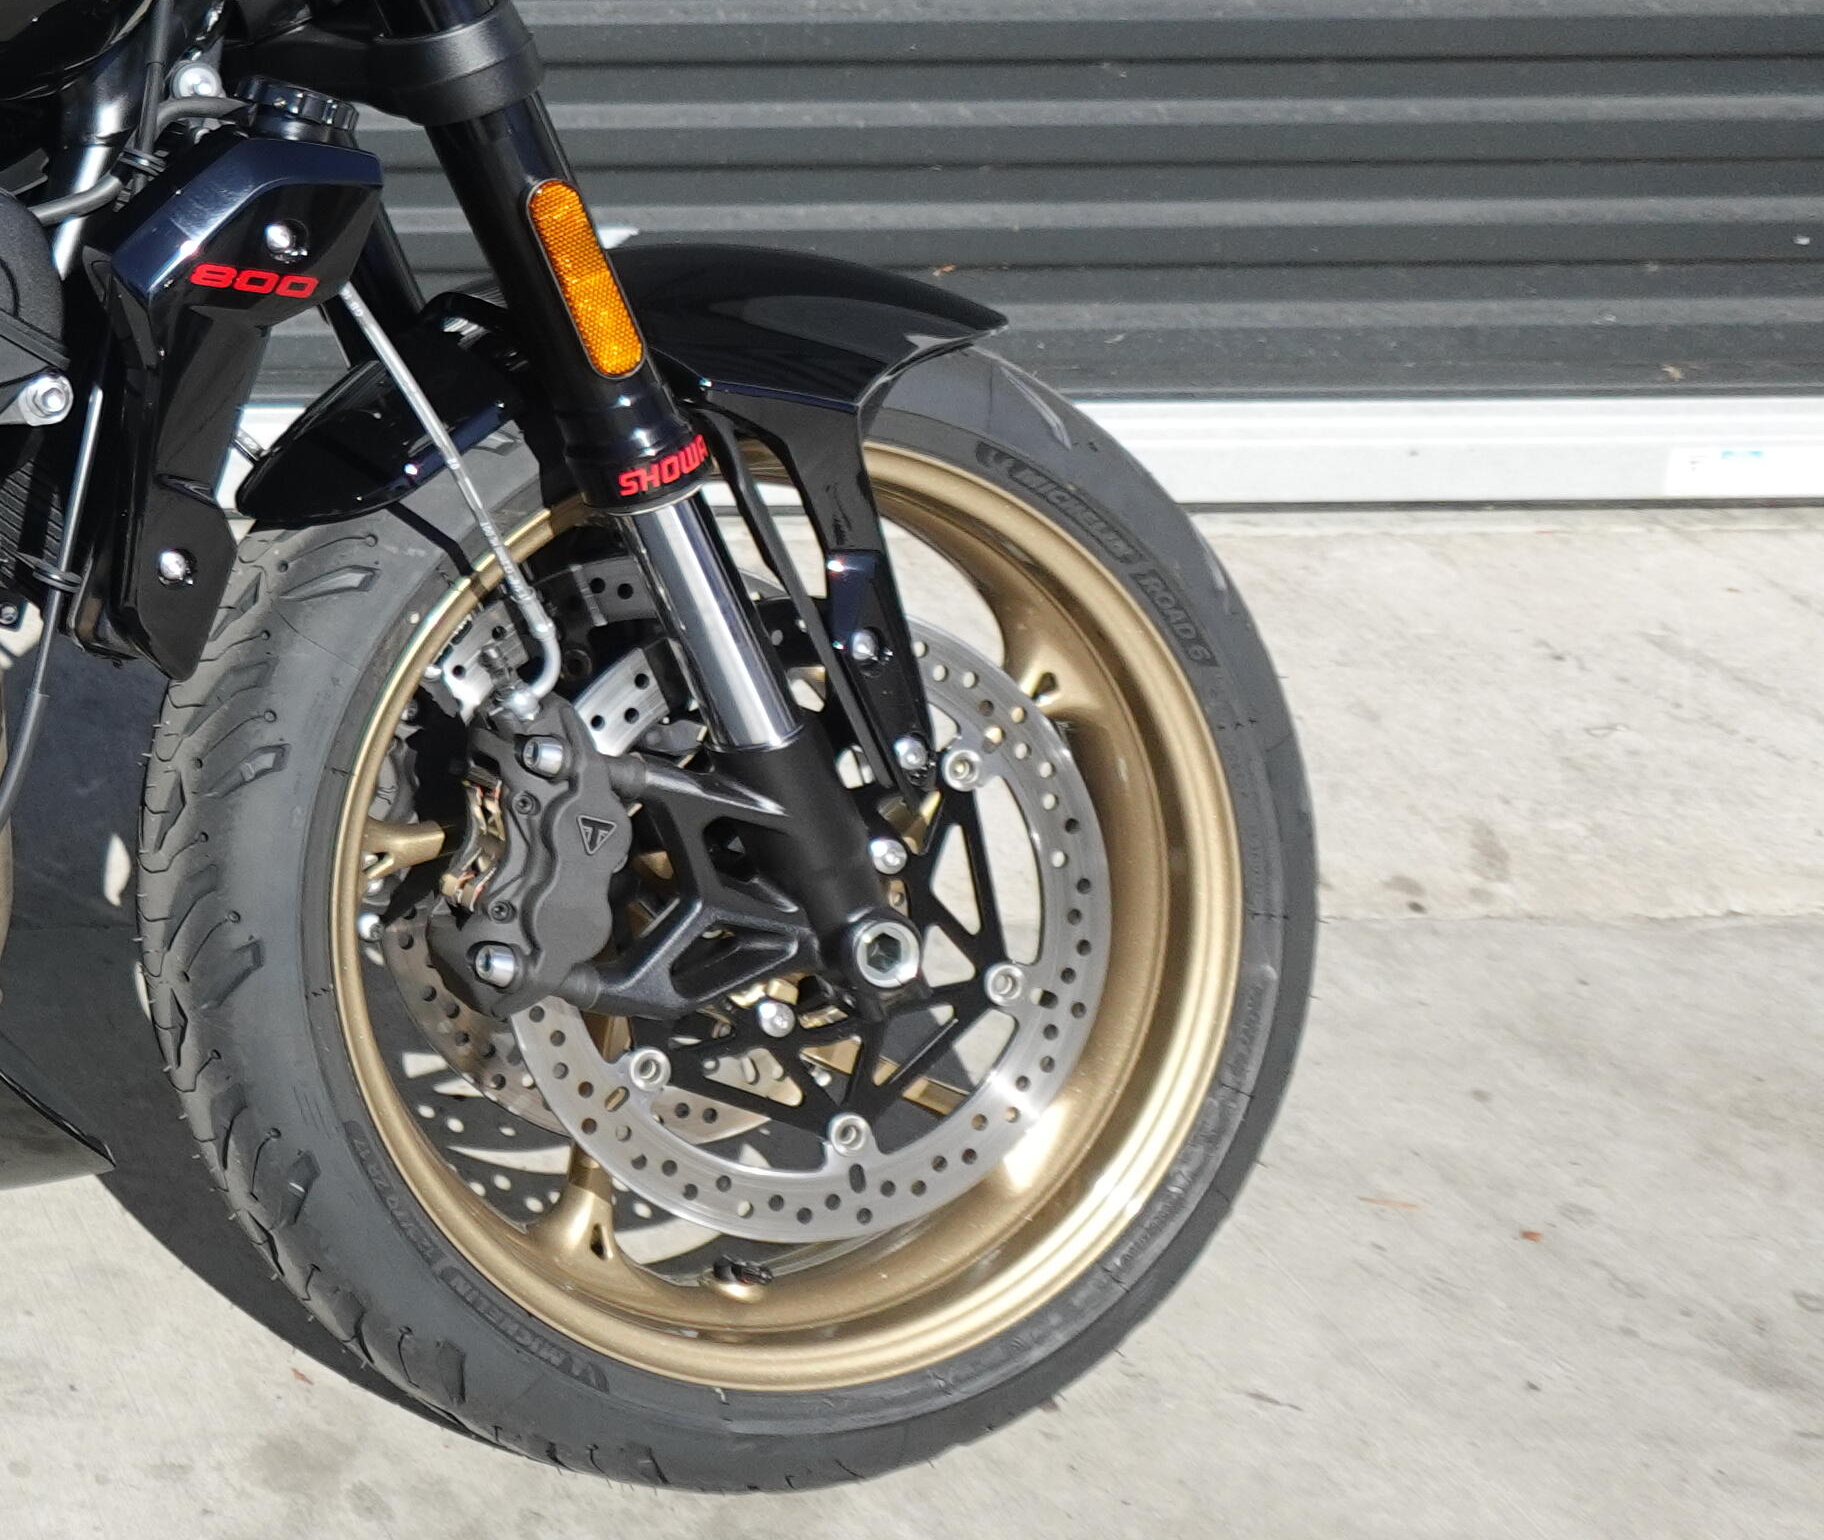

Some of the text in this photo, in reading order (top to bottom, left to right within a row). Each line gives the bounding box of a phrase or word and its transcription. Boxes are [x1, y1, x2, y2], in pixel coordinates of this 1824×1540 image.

[190, 263, 319, 299] 800
[617, 433, 709, 497] SHOWA
[1014, 467, 1212, 662] MICHELIN ROAD 6
[351, 1138, 372, 1161] 17
[449, 1271, 565, 1366] MICHELIN
